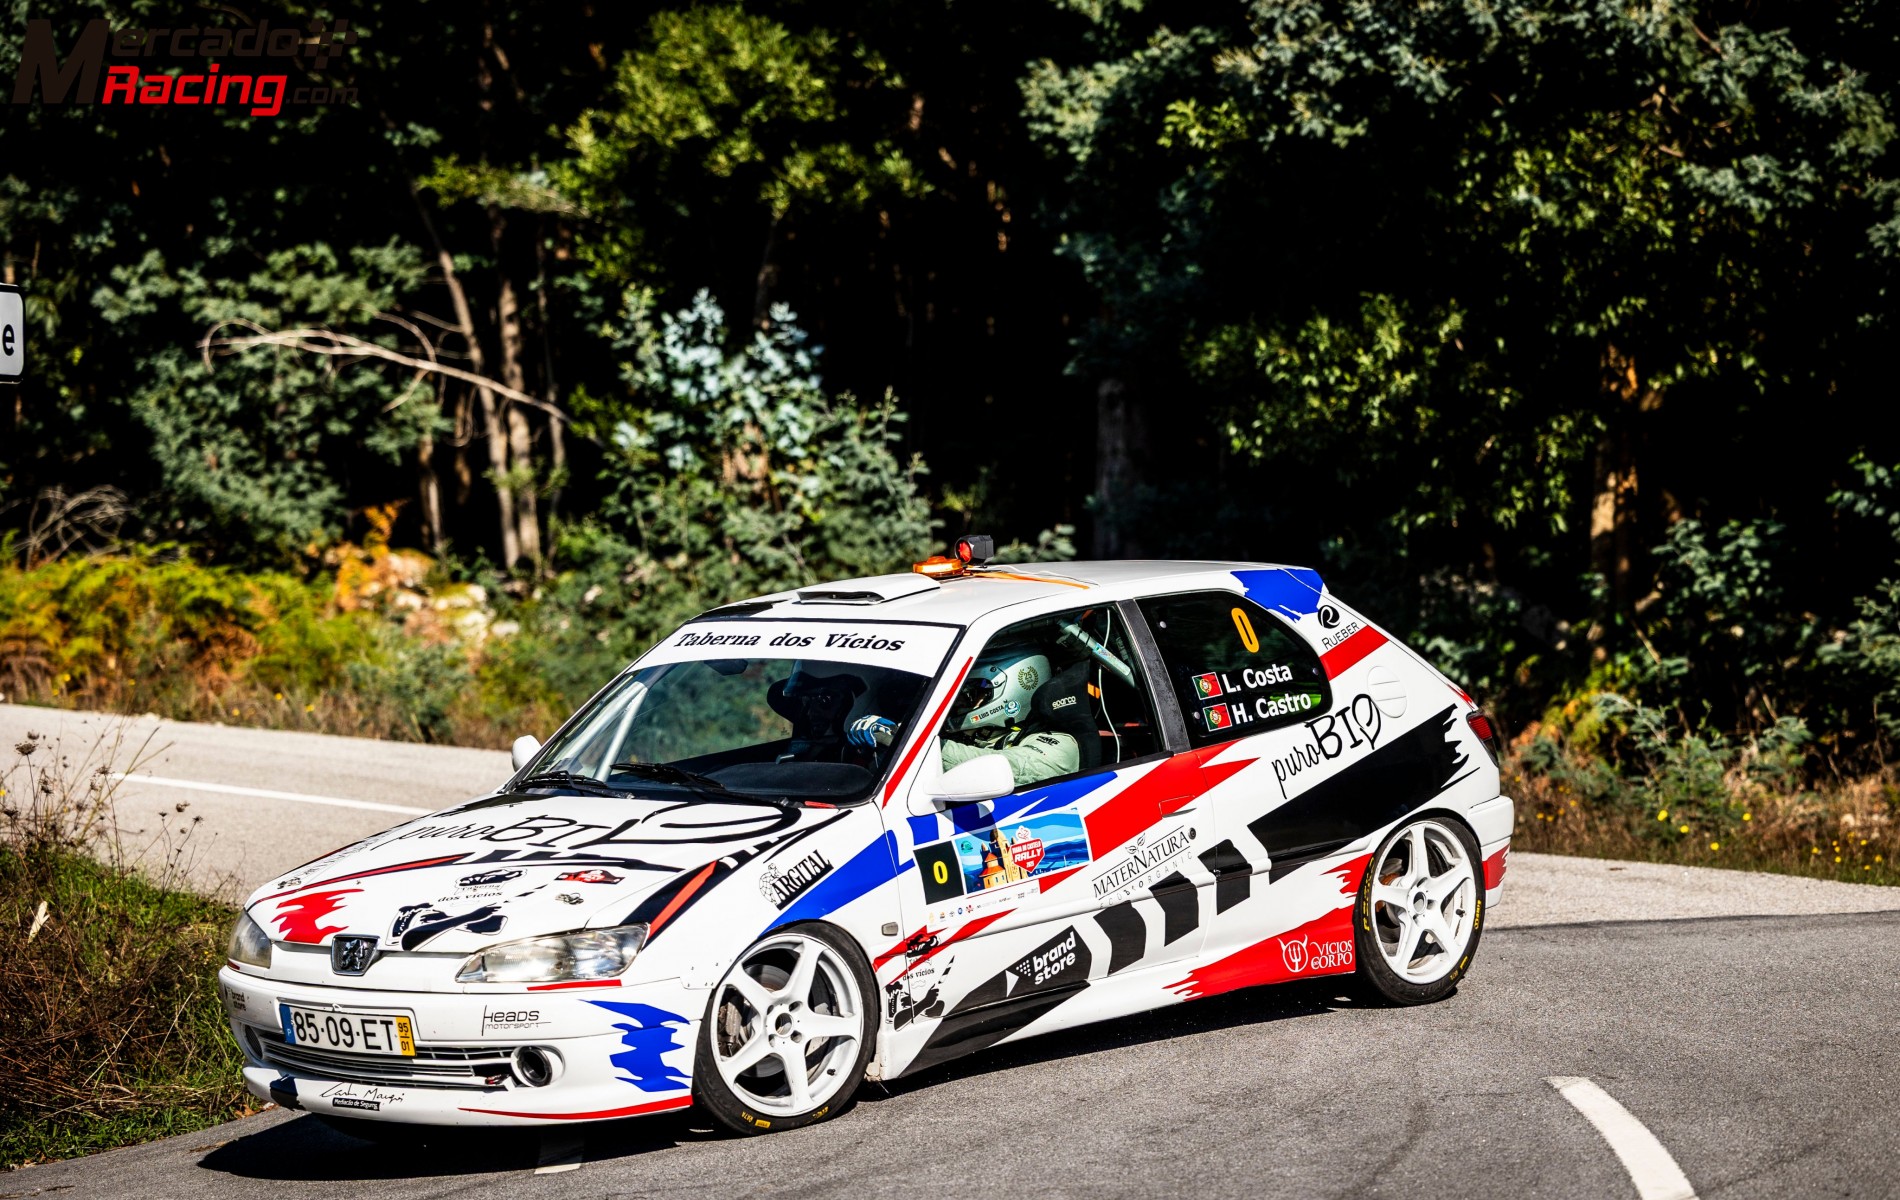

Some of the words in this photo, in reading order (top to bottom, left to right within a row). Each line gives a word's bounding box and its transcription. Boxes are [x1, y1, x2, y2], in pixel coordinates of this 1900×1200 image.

[673, 632, 761, 648] Taberna
[768, 632, 815, 648] dos
[823, 633, 906, 651] Vícios
[1231, 607, 1260, 654] 0
[1321, 621, 1360, 650] RUEBER
[1222, 673, 1242, 693] L.
[1243, 663, 1293, 689] Costa
[989, 704, 1005, 716] COSTA
[1231, 702, 1254, 725] H.
[1255, 692, 1312, 720] Castro
[1014, 848, 1042, 863] RALLY
[771, 848, 834, 902] ARGITAL
[932, 860, 949, 885] 0
[1032, 930, 1077, 973] brand
[1034, 952, 1076, 985] store
[401, 1041, 411, 1051] 01
